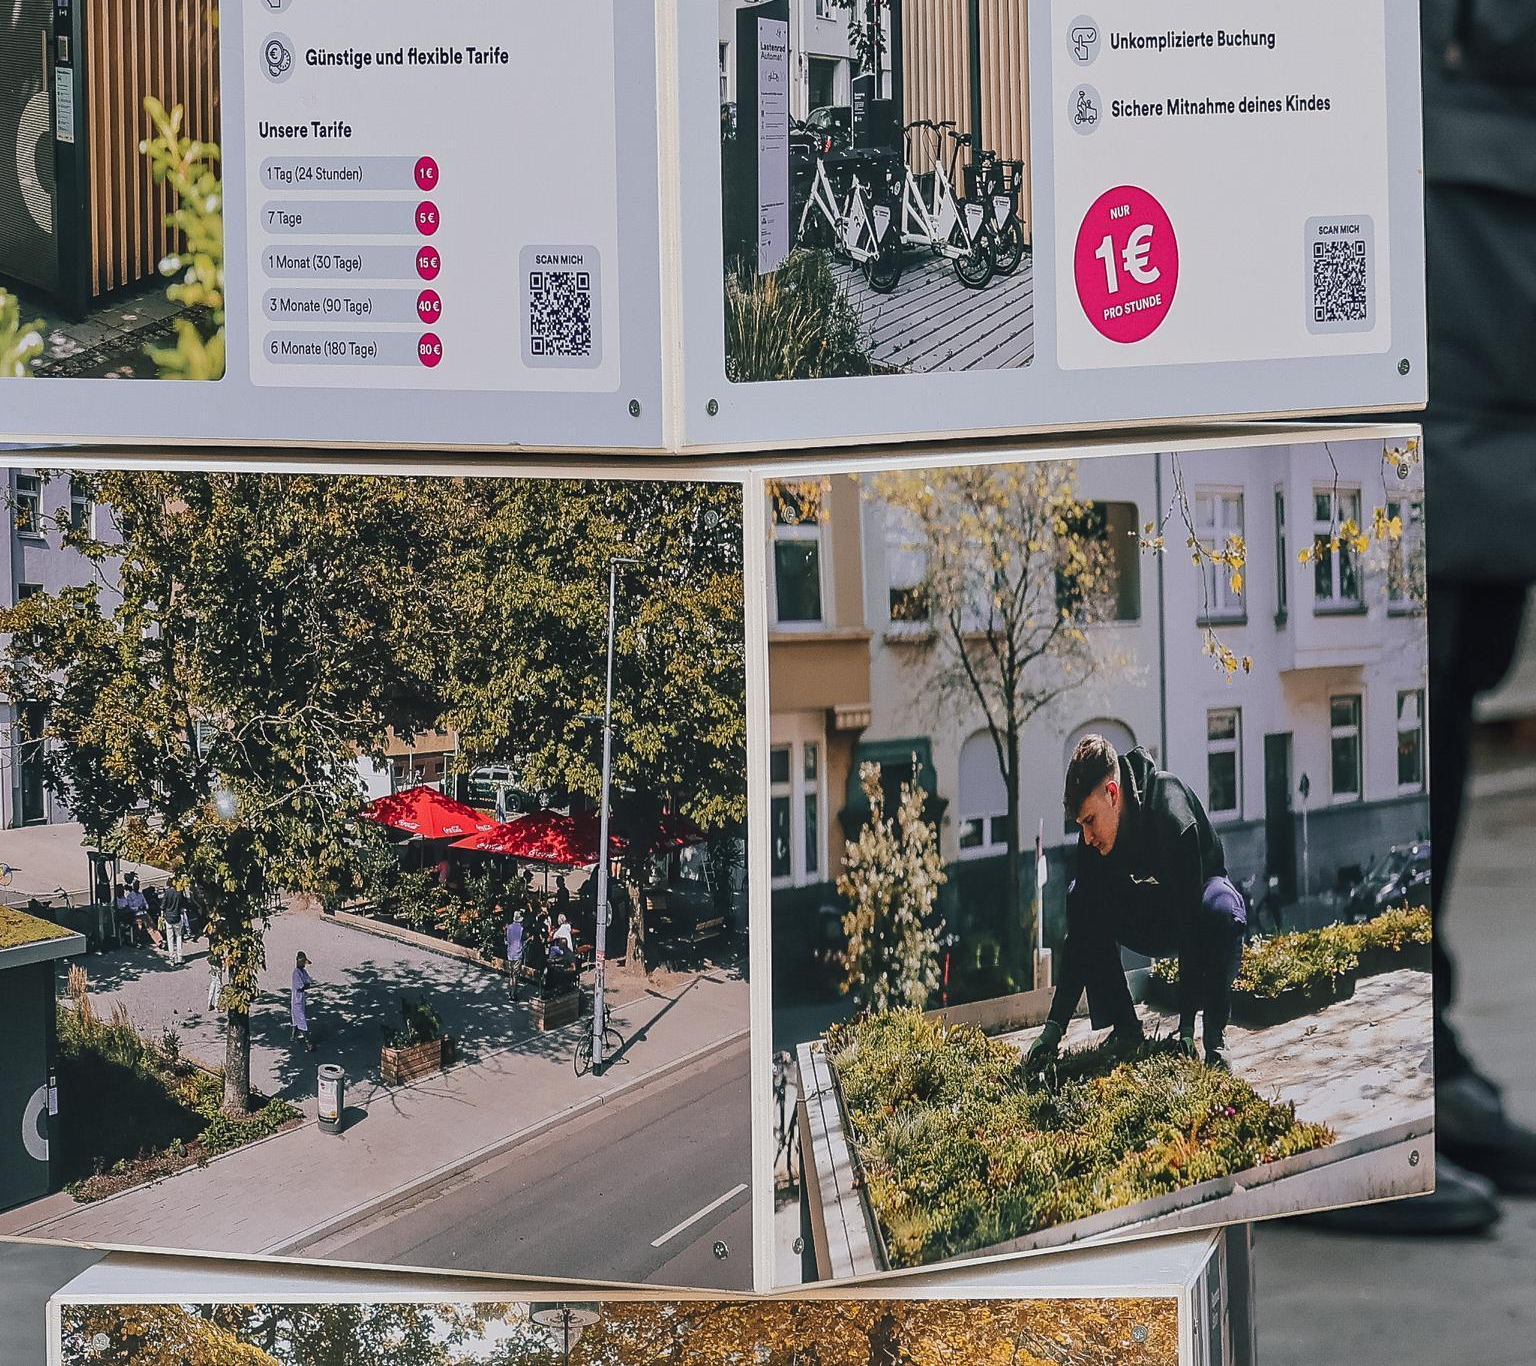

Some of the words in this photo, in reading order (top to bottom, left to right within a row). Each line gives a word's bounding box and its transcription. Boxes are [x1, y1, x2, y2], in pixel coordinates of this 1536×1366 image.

[1110, 30, 1213, 52] Unkomplizierte
[1217, 29, 1275, 49] Buchung
[305, 47, 372, 69] Günstige
[376, 47, 403, 65] und
[407, 46, 462, 65] flexible
[465, 46, 509, 64] Tarife
[1111, 99, 1163, 117] Sichere
[1167, 97, 1235, 115] Mitnahme
[1238, 95, 1282, 113] deines
[1285, 94, 1330, 112] Kindes
[259, 121, 308, 138] Unsere
[310, 120, 352, 138] Tarife
[267, 166, 271, 180] 1
[273, 166, 292, 184] Tag
[295, 165, 313, 182] (24
[315, 165, 362, 183] Stunden)
[267, 211, 275, 224] 7
[276, 211, 302, 227] Tage
[1110, 204, 1130, 220] NUR
[1318, 225, 1339, 235] SCAN
[1340, 224, 1359, 234] MICH
[268, 255, 273, 268] 1
[276, 255, 310, 268] Monat
[312, 254, 331, 271] (30
[333, 254, 361, 272] Tage)
[535, 254, 559, 264] SCAN
[560, 255, 583, 264] MICH
[270, 298, 277, 311] 3
[280, 298, 320, 312] Monate
[322, 297, 341, 314] (90
[343, 298, 372, 315] Tage)
[1103, 305, 1123, 320] PRO
[1124, 293, 1162, 314] STUNDE
[270, 340, 278, 354] 6
[281, 340, 321, 355] Monate
[324, 340, 346, 357] (180
[348, 341, 377, 359] Tage)
